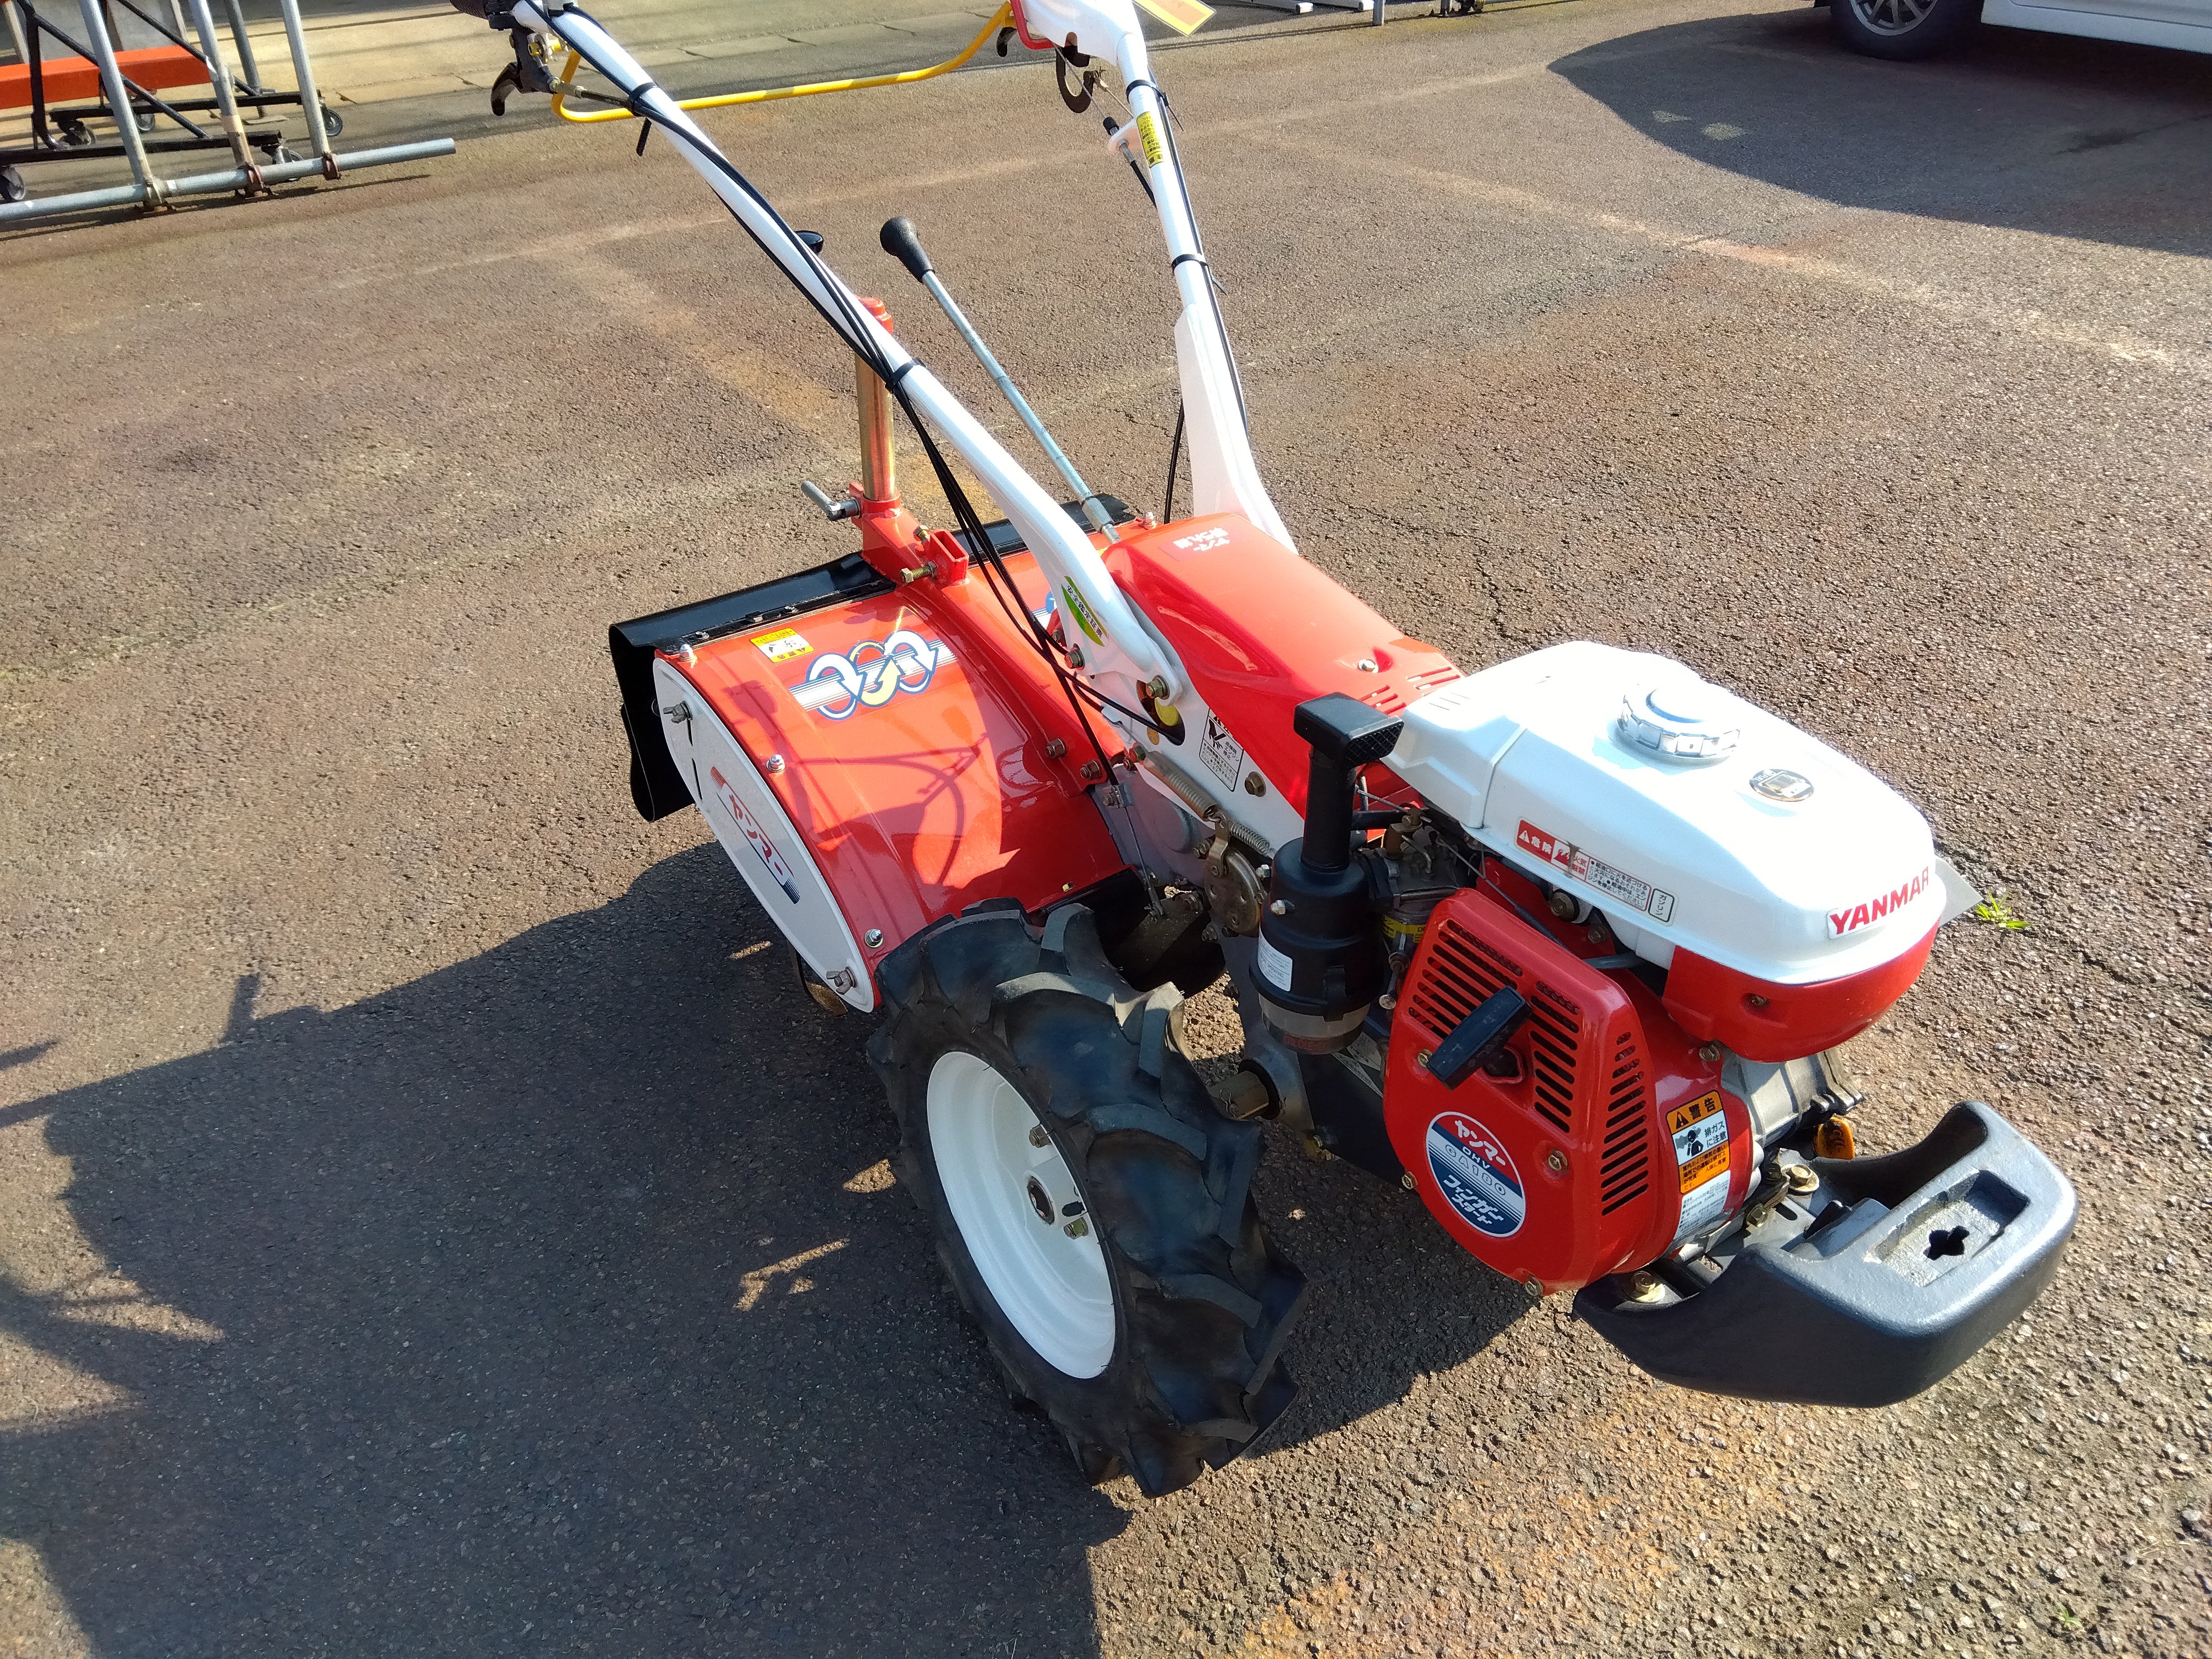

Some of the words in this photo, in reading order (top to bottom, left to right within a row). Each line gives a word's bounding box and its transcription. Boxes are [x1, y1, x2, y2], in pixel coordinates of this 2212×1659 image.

[1067, 585, 1103, 638] 安全鑑定証票
[1224, 750, 1231, 760] 停止
[1225, 741, 1237, 755] 点検時
[1225, 747, 1239, 761] エンジン
[729, 794, 783, 876] ヤンマー
[1531, 836, 1552, 854] 危険
[1655, 894, 1667, 916] ガソリン
[1830, 866, 1929, 935] YANMAR
[1688, 1097, 1716, 1120] 警告
[1704, 1120, 1725, 1138] 排ガス
[1707, 1131, 1727, 1147] に注意
[1455, 1120, 1506, 1166] ヤンマー
[1462, 1146, 1491, 1169] OHV
[1445, 1144, 1506, 1195] GA180
[1444, 1175, 1504, 1221] フィンガー
[1452, 1194, 1493, 1225] スタート
